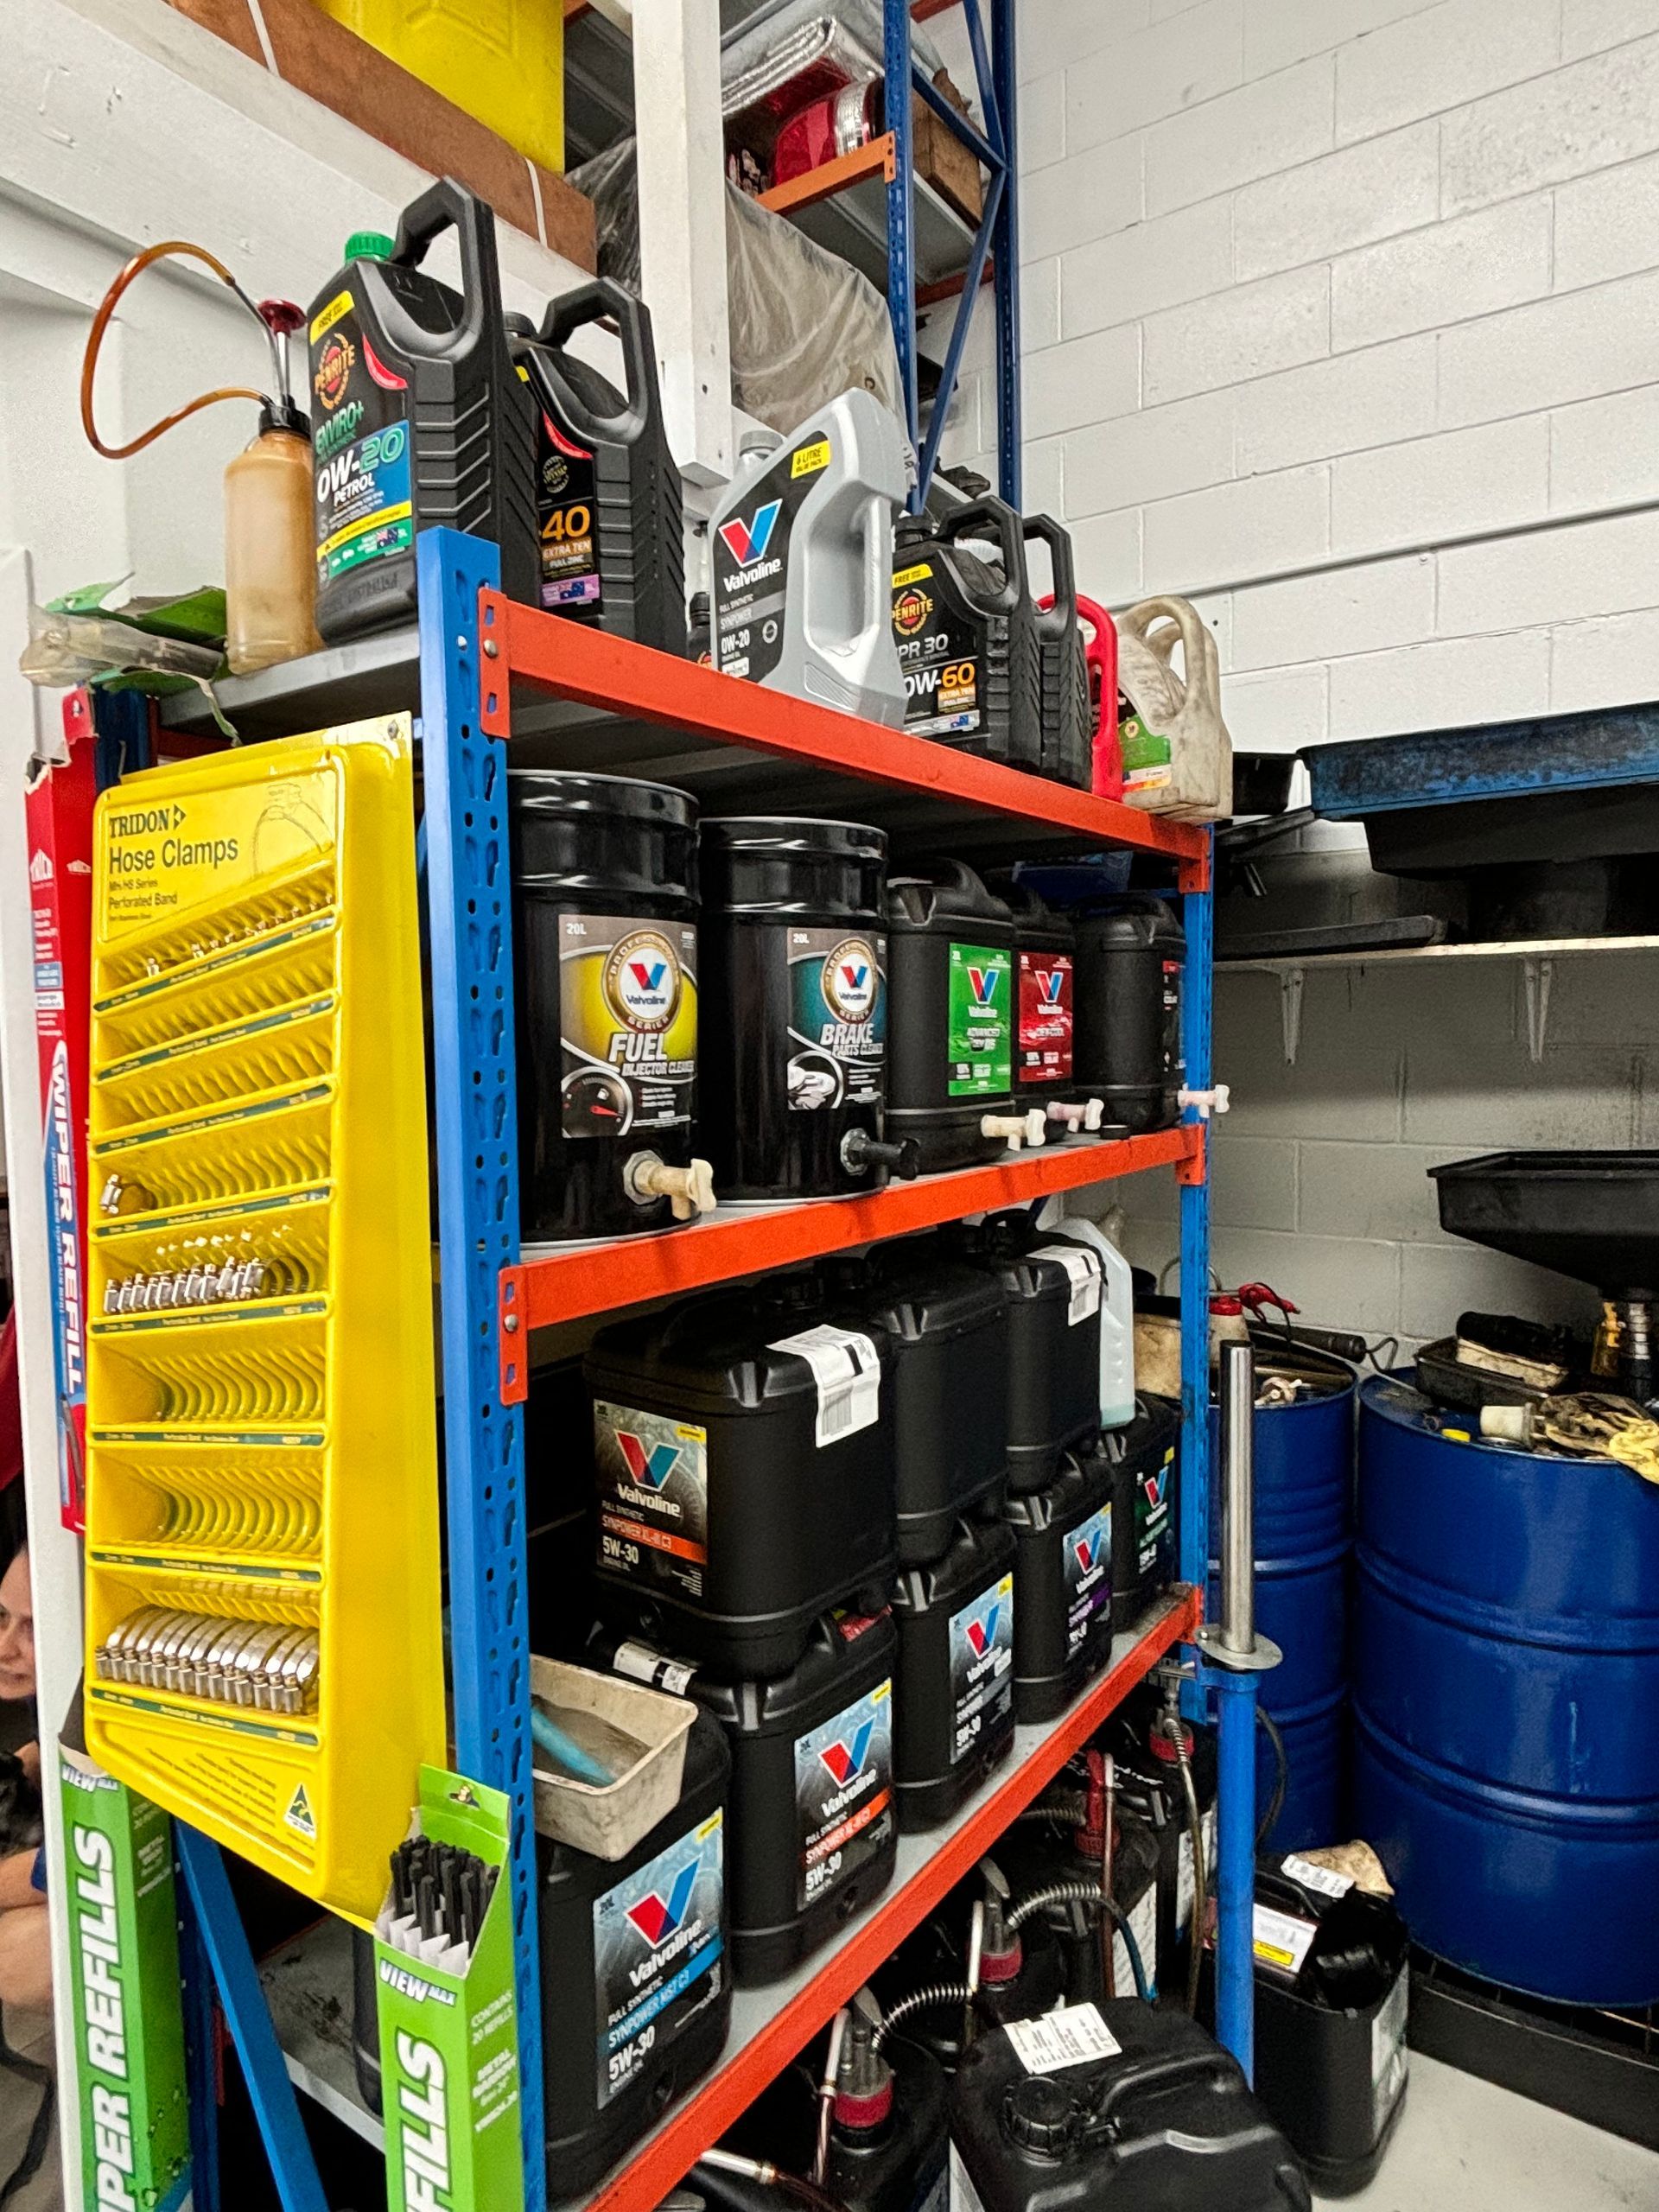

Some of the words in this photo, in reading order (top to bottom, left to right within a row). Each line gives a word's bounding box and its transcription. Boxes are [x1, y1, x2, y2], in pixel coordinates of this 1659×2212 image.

[317, 428, 404, 503] 0W-20
[334, 473, 376, 507] PETROL
[543, 543, 571, 560] EXTRA
[573, 539, 592, 555] TEN
[723, 558, 783, 593] Valvoline
[721, 628, 750, 654] 0W-20
[924, 633, 949, 655] 30
[109, 808, 170, 839] TRIDON
[109, 846, 156, 874] Hose
[162, 838, 238, 870] Clamps
[109, 895, 153, 910] Perforated
[154, 890, 178, 906] Band
[566, 923, 588, 936] 20L
[607, 1033, 668, 1063] FUEL
[819, 1023, 875, 1046] BRAKE
[620, 1062, 668, 1077] INJECTOR
[53, 1062, 73, 1223] WIPER
[61, 1232, 82, 1395] REFILL
[617, 1483, 681, 1518] Valvoline
[602, 1535, 639, 1565] 5W-30
[821, 1769, 877, 1817] Valvoline
[74, 1824, 129, 2080] REFILLS
[628, 1919, 702, 1987] Valvoline
[608, 1997, 660, 2049] SYNPOWER
[608, 2024, 656, 2081] 5W-30
